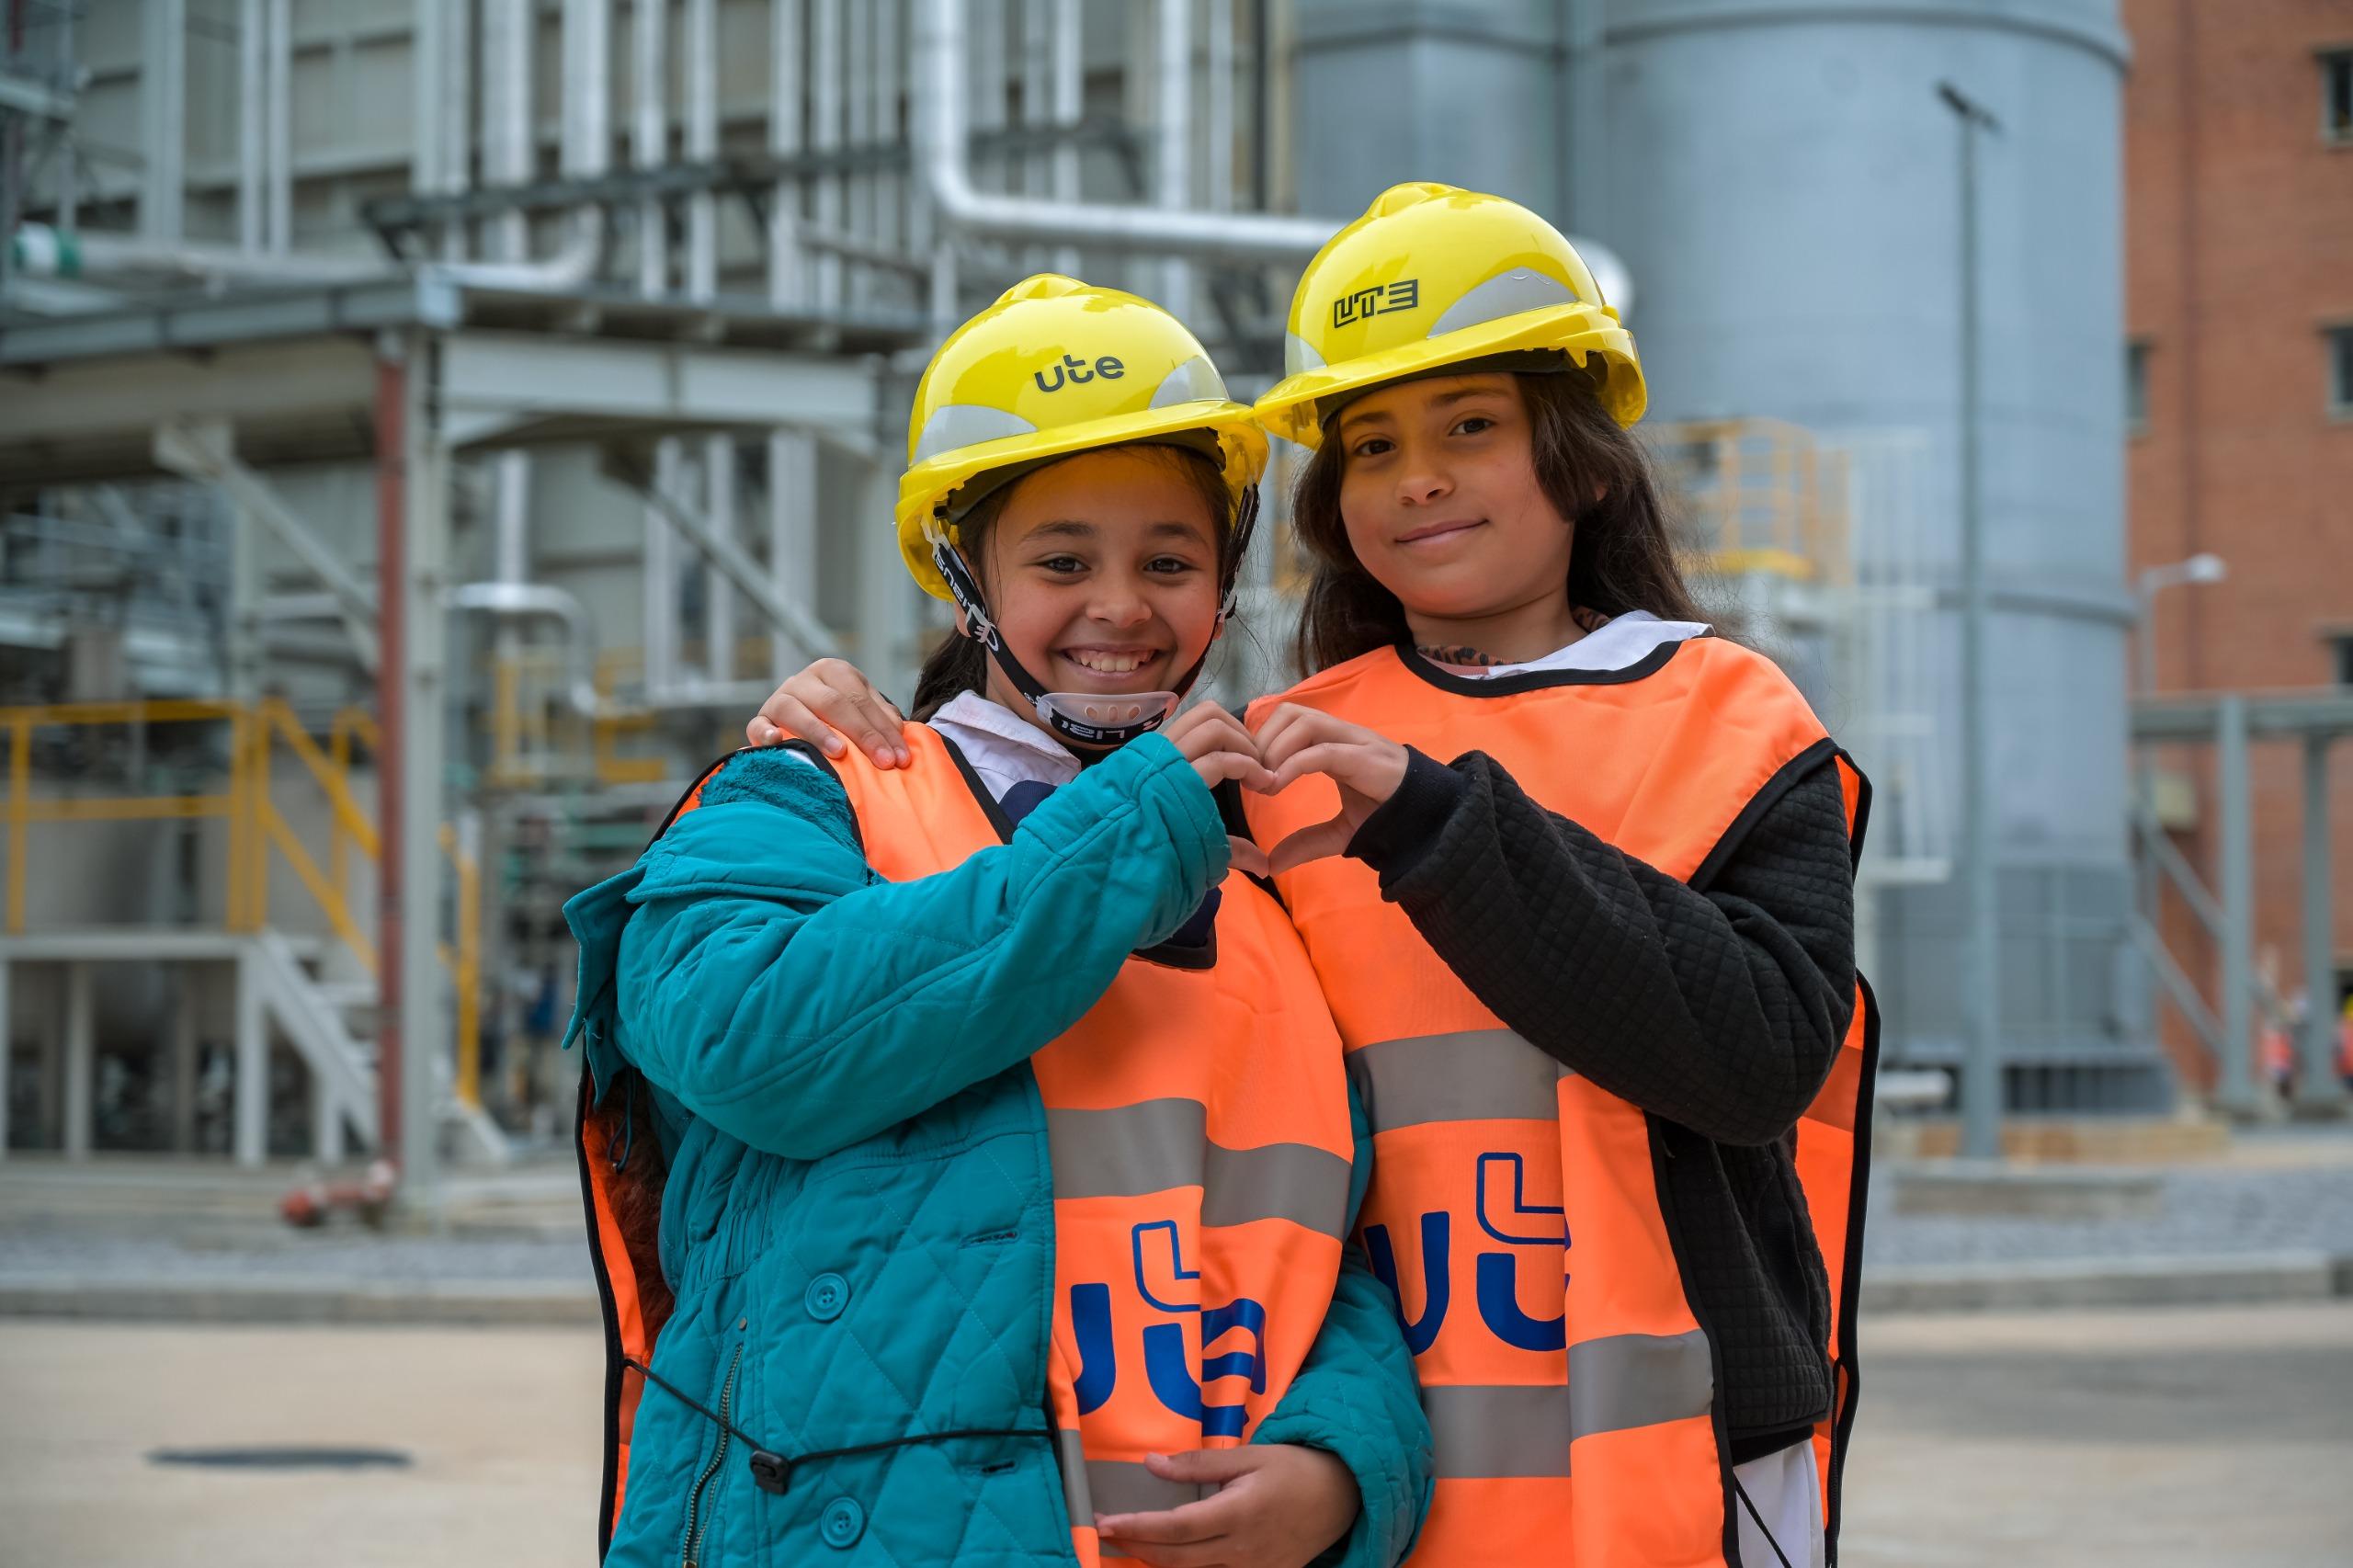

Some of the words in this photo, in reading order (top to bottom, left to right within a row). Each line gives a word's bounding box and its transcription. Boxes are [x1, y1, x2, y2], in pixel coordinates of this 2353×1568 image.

[1334, 279, 1417, 328] UTE
[1034, 355, 1124, 392] ute
[935, 551, 972, 608] IBUS
